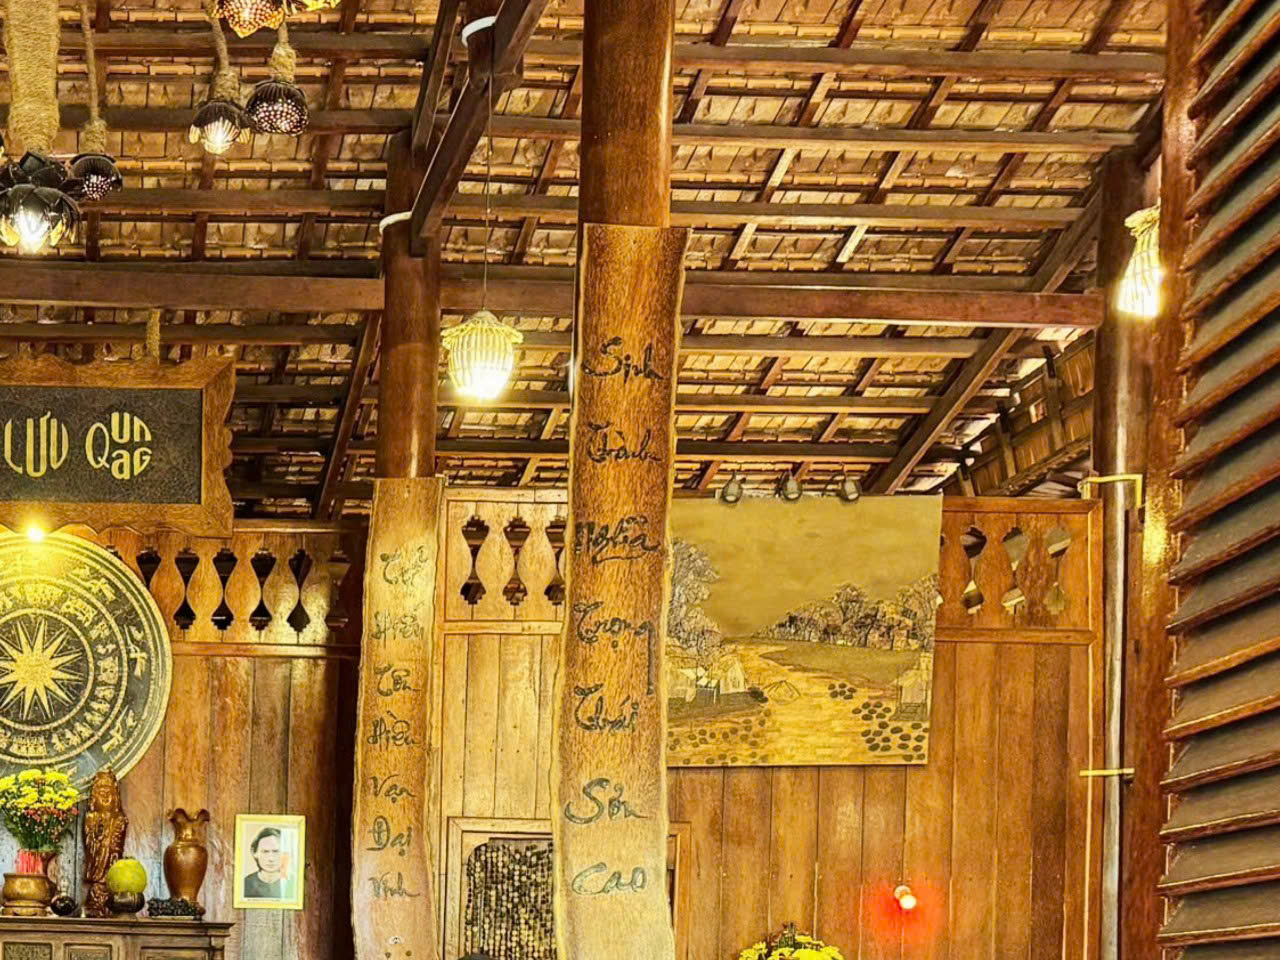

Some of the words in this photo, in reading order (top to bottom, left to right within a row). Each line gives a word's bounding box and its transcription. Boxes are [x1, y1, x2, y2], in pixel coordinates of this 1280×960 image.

[580, 335, 664, 385] Sinh
[585, 423, 664, 464] Thành
[573, 600, 656, 696] Trọng
[575, 682, 640, 734] Thái
[368, 773, 418, 804] Vạn
[564, 777, 650, 826] Sơn
[365, 814, 413, 857] Đại
[367, 870, 422, 899] Vinh
[572, 861, 648, 895] Cao
